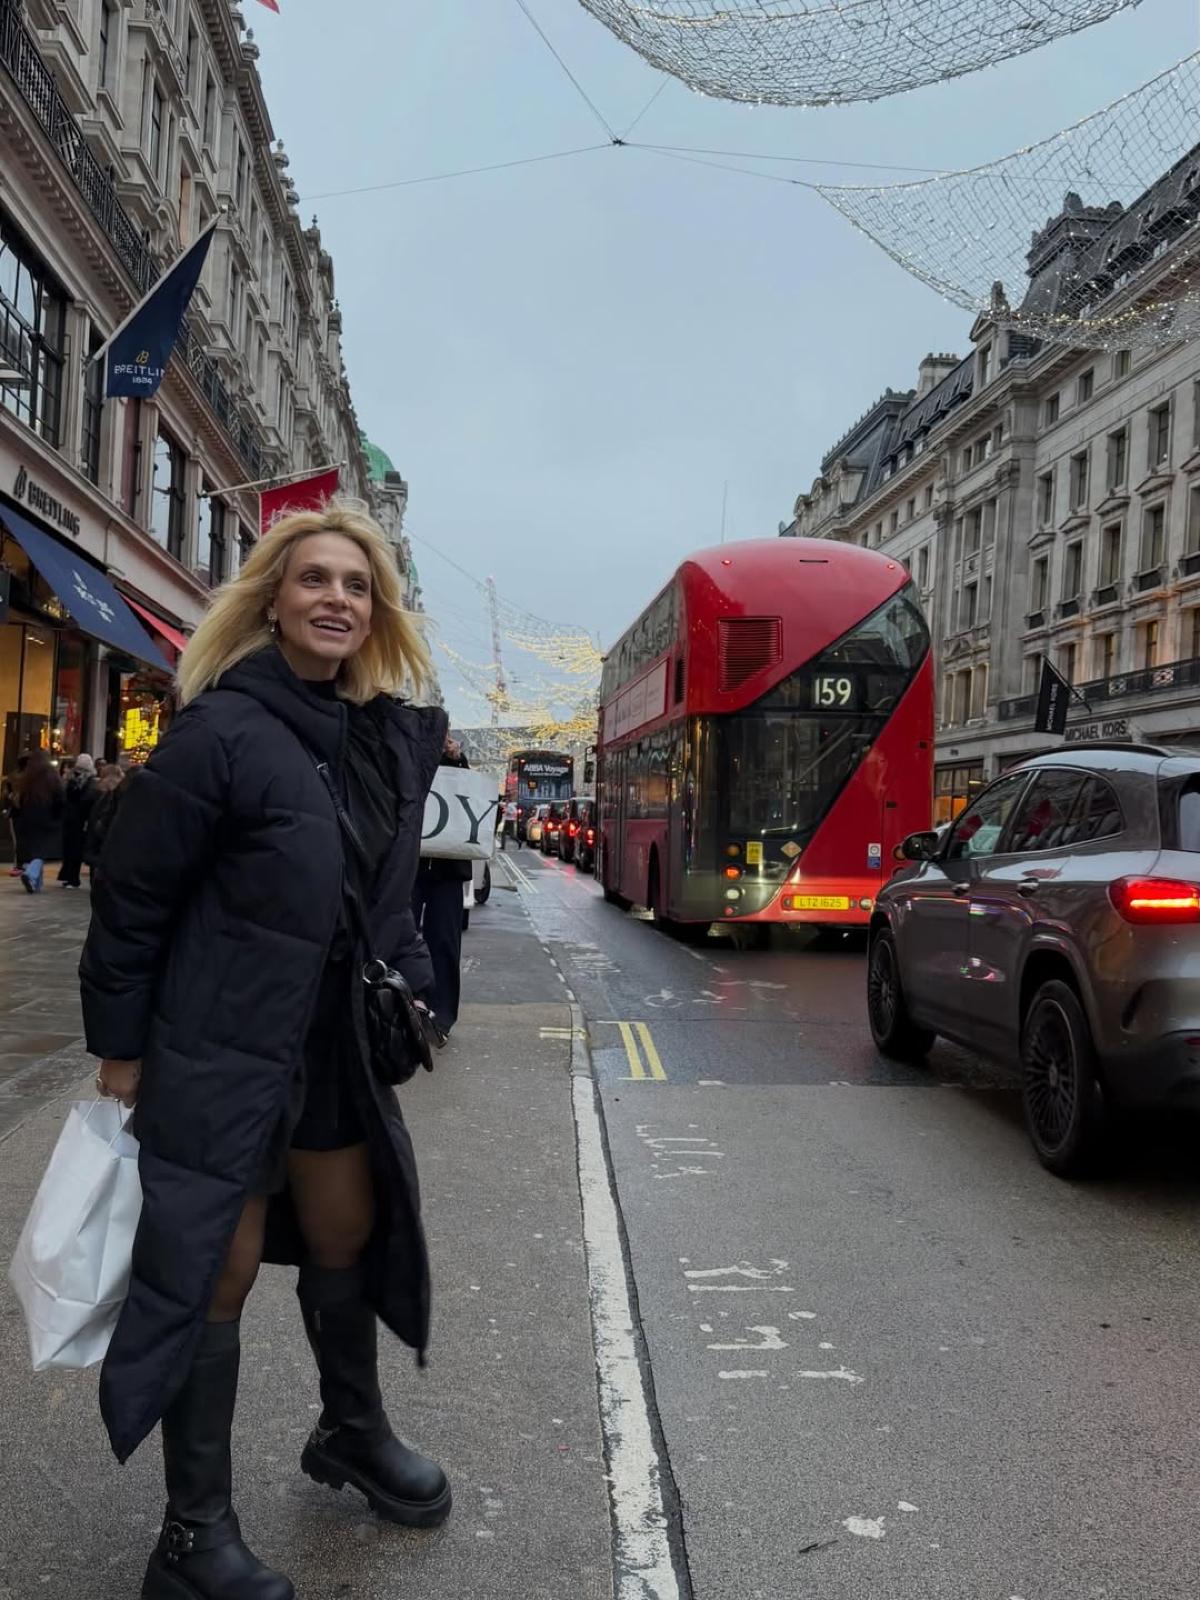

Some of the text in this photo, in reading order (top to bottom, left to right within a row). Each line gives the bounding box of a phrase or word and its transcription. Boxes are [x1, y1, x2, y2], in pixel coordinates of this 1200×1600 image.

[28, 481, 81, 537] BREITLING
[815, 678, 852, 705] 159
[1066, 720, 1127, 740] MICHAEL KORS
